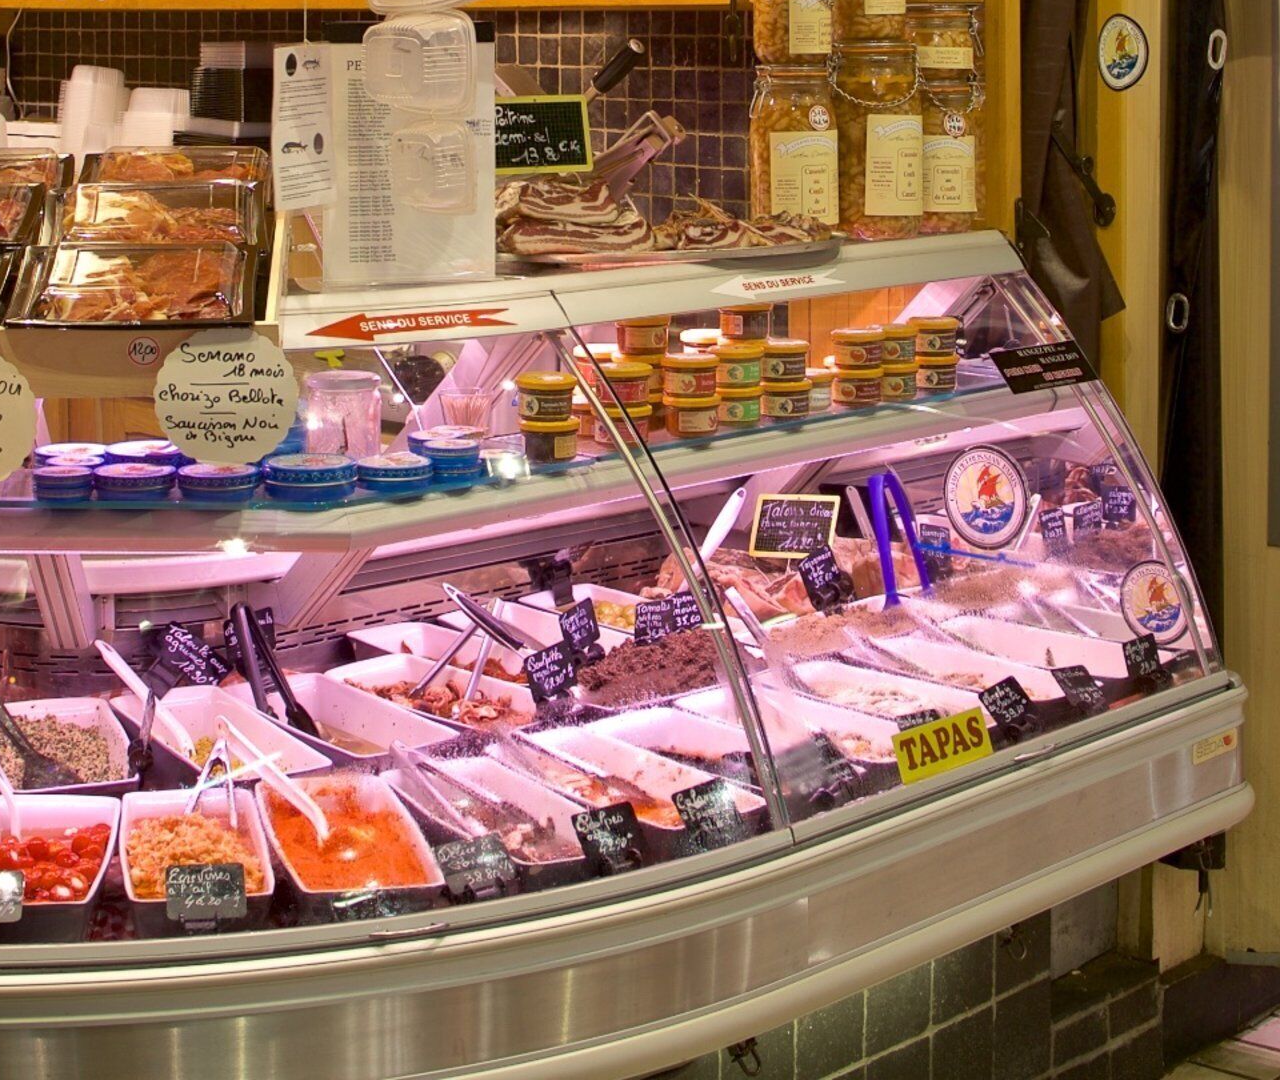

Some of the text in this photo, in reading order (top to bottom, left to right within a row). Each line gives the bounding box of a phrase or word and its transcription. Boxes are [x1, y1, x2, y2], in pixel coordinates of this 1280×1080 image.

[742, 274, 815, 292] SENS DU SERVICE
[360, 312, 471, 333] SENS DU SERVICE
[250, 364, 284, 378] mois
[900, 716, 984, 771] TAPAS
